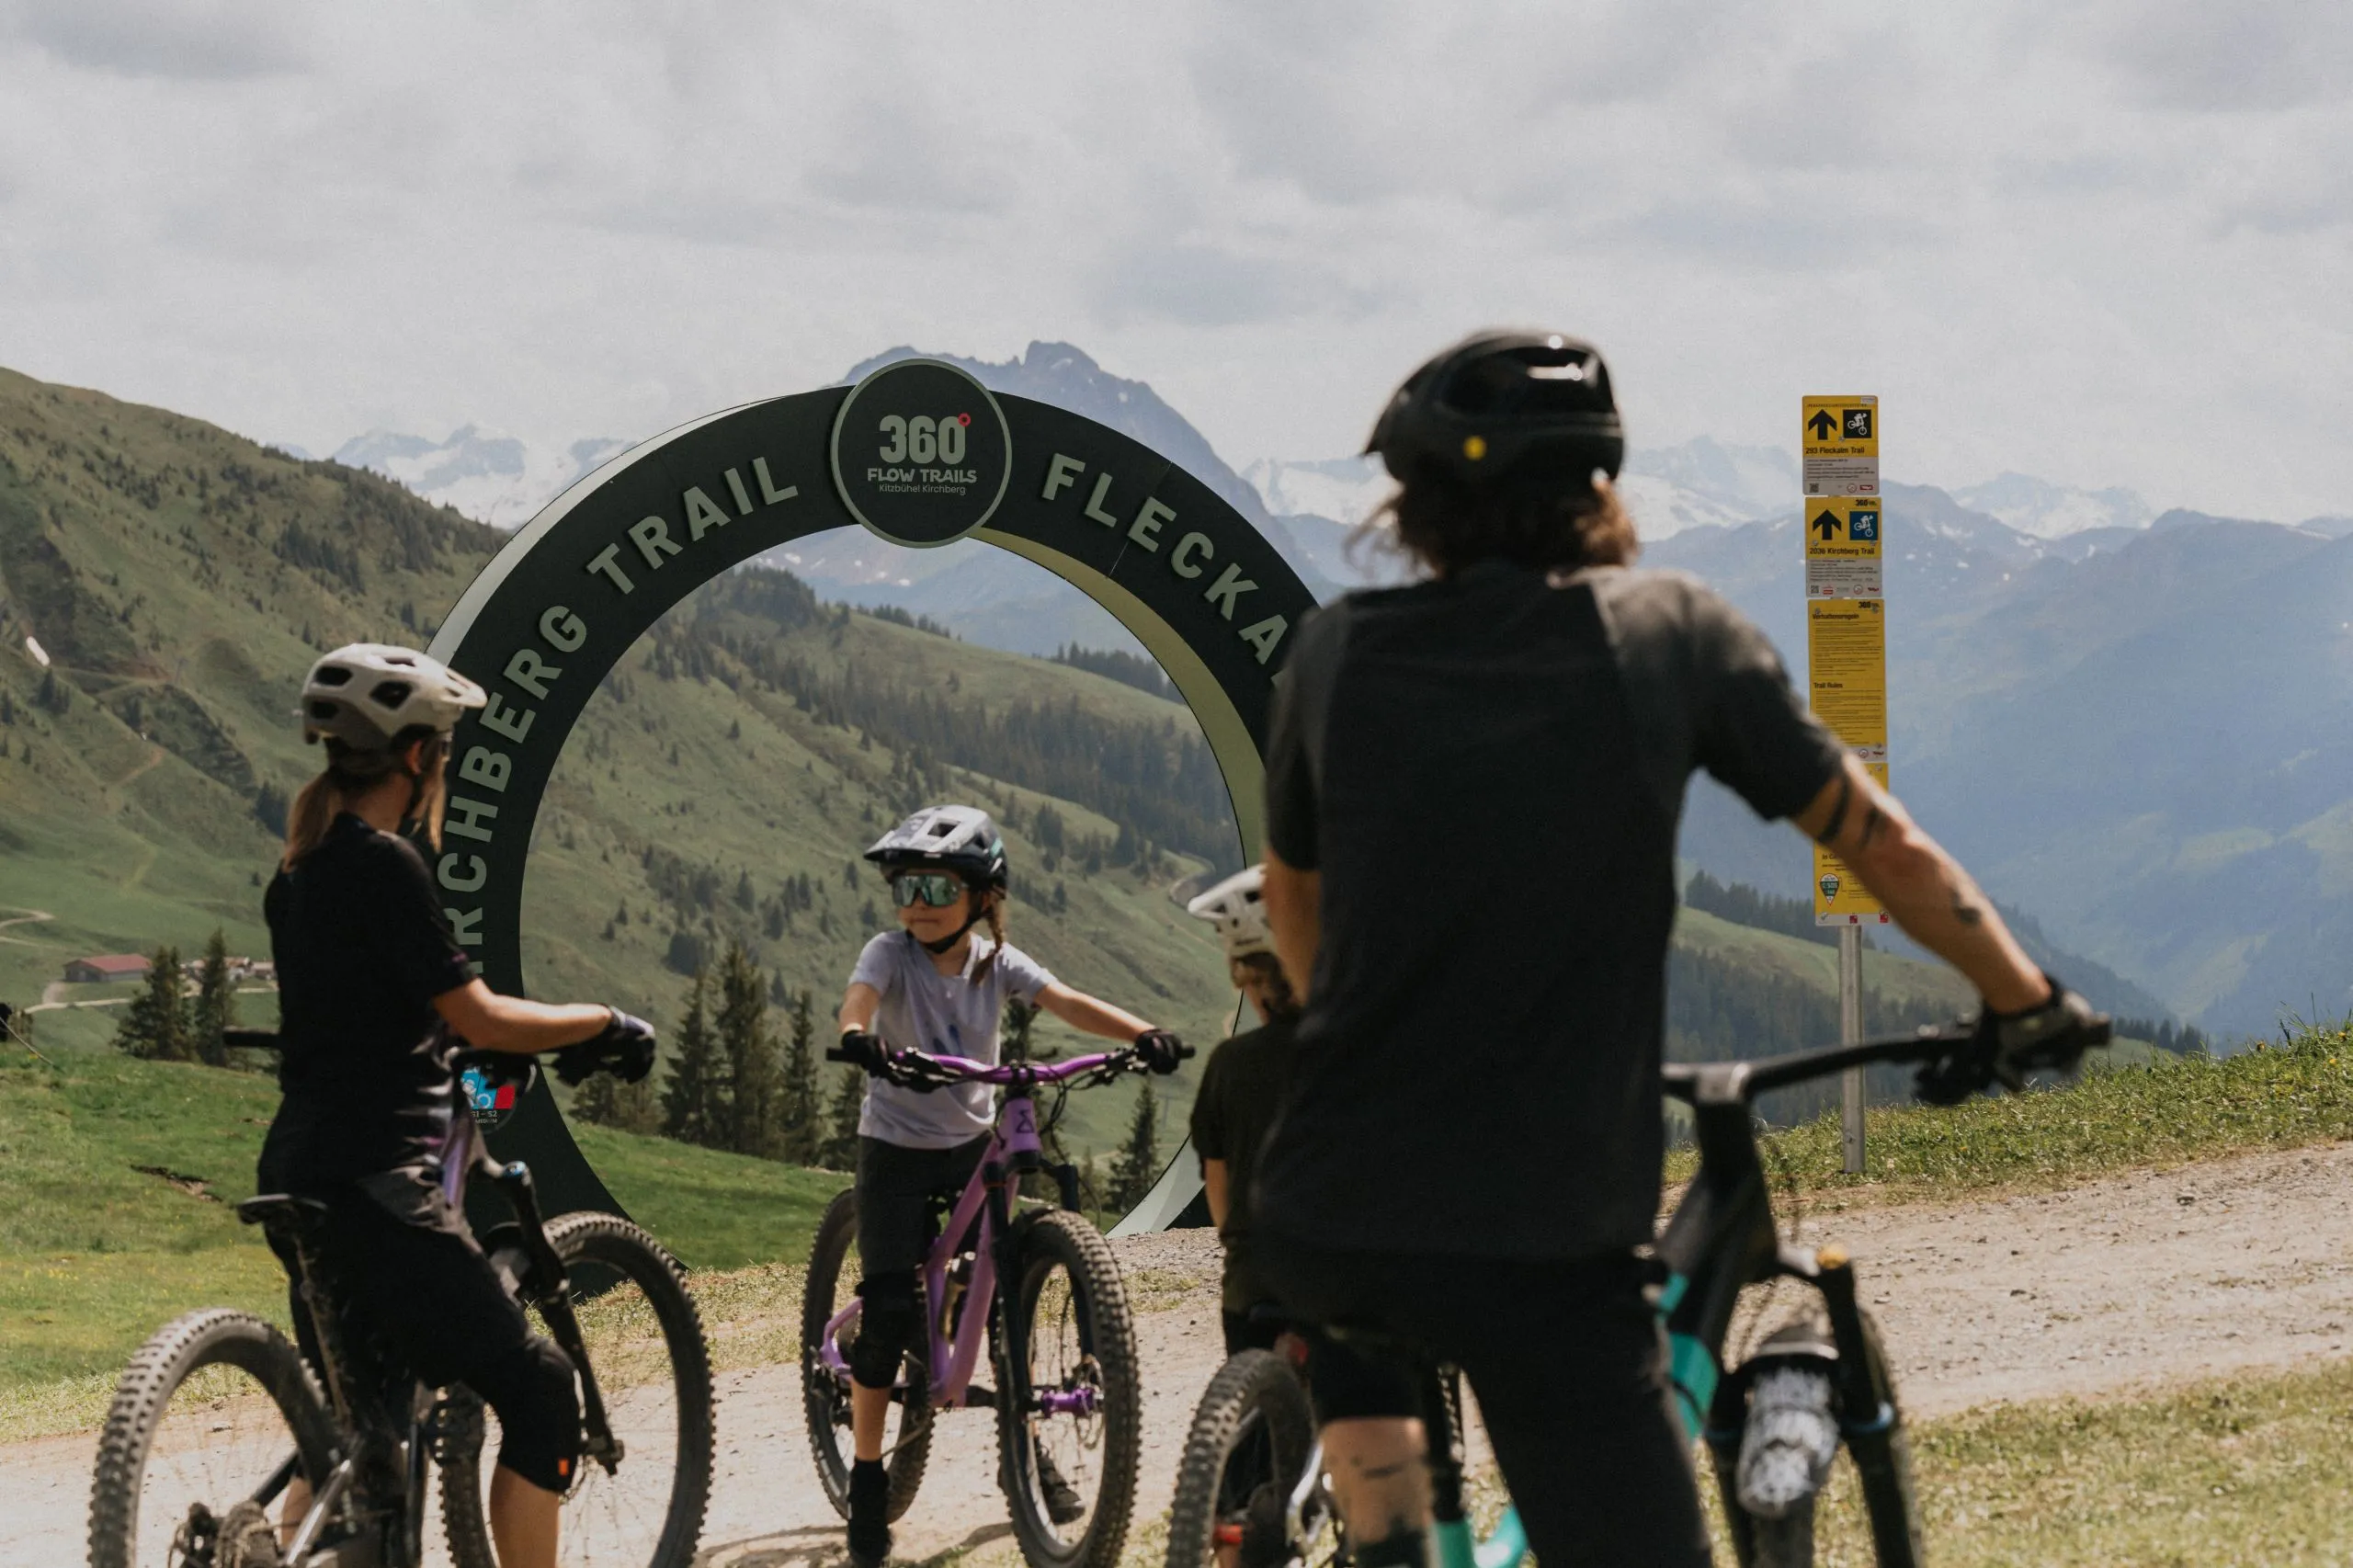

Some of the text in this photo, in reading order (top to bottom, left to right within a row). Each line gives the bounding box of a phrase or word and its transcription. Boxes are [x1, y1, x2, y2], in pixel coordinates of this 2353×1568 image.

[1851, 446, 1865, 454] Trail
[867, 468, 978, 483] FLOW TRAILS
[879, 483, 967, 496] Kitzbühel Kirchberg
[1827, 547, 1859, 556] Kirchberg
[1861, 547, 1875, 555] Trail
[1041, 452, 1289, 687] FLECKA
[438, 457, 799, 973] RCHBERG TRAIL
